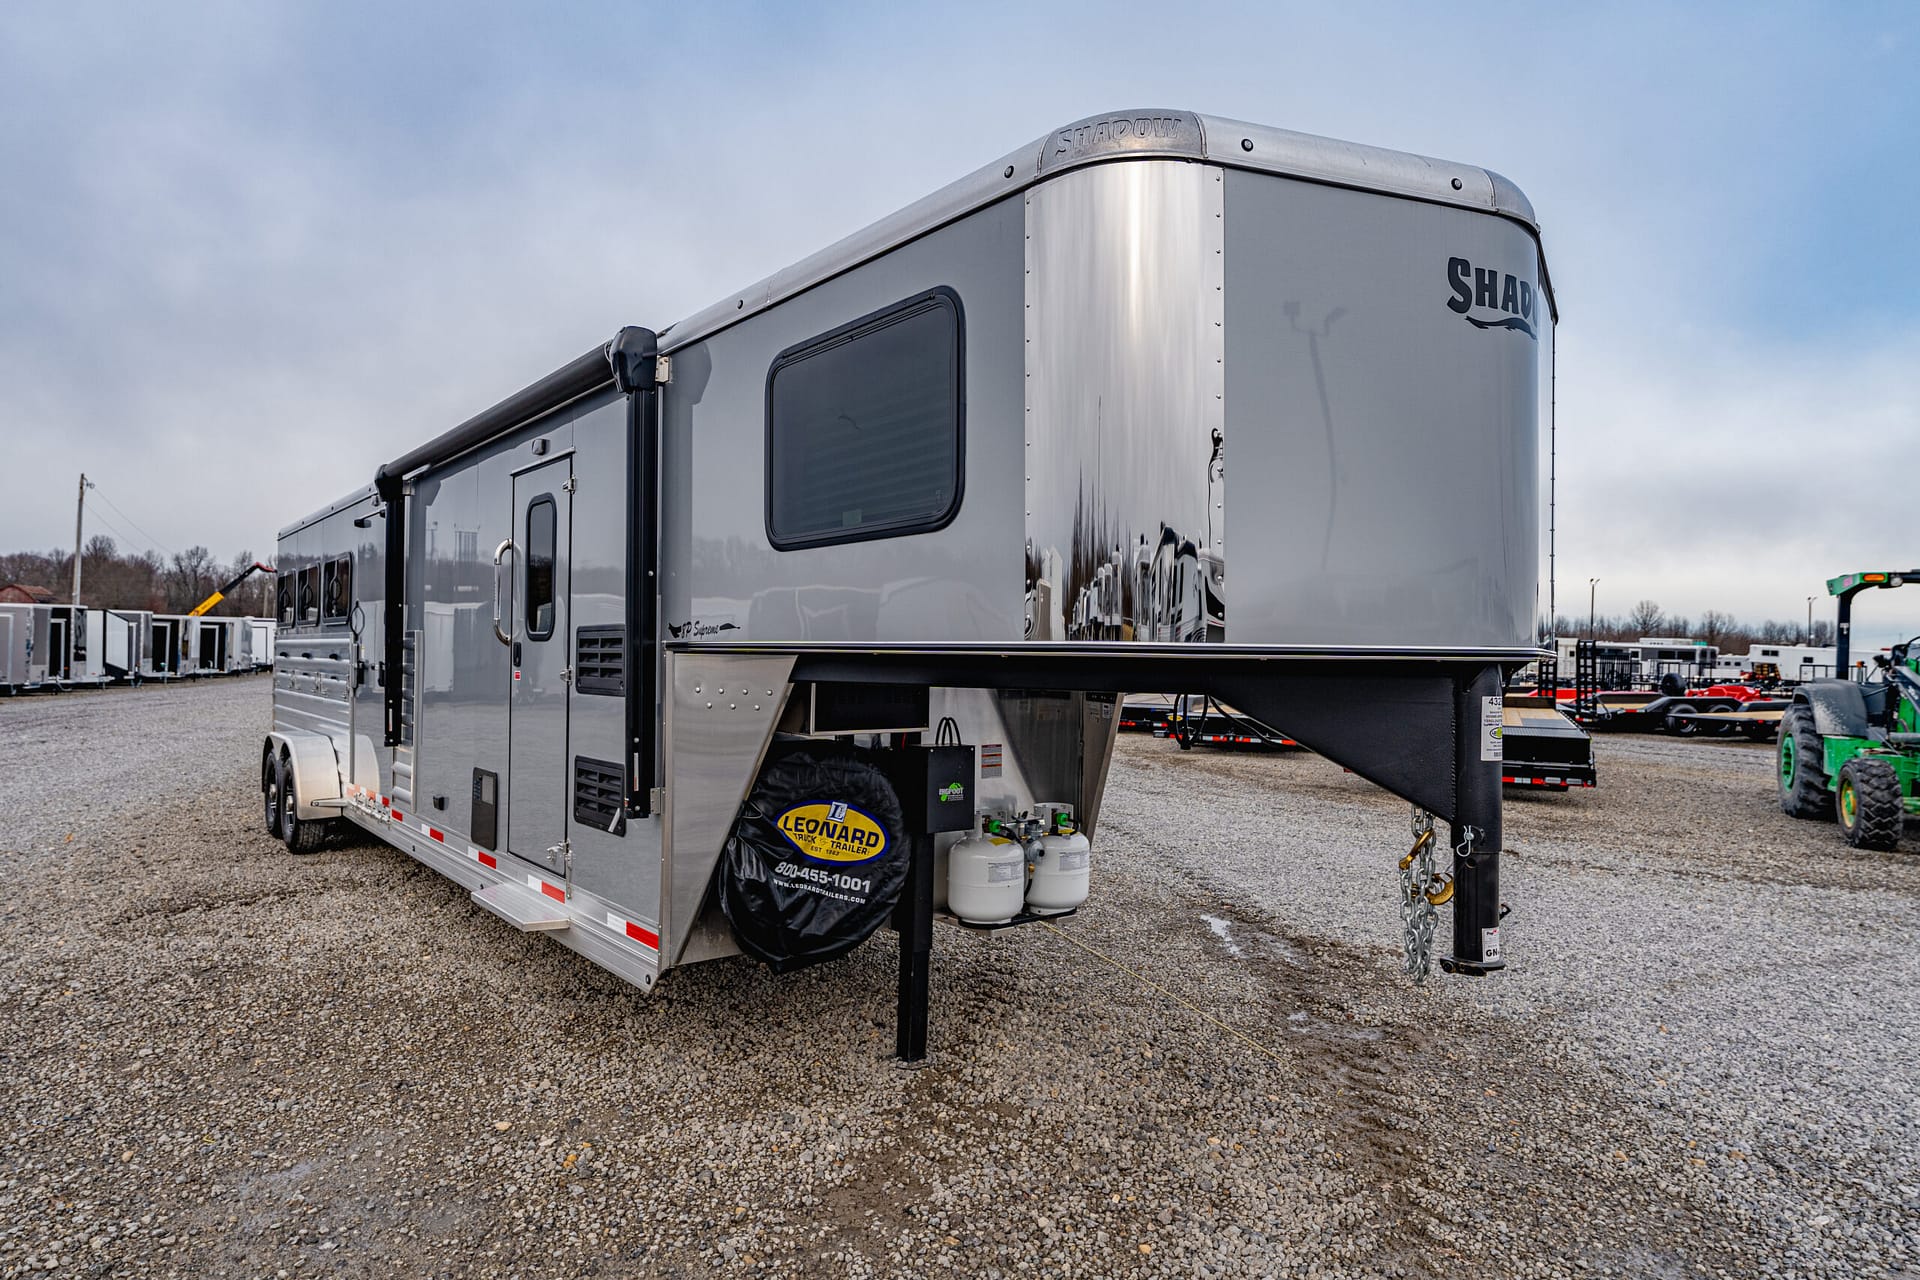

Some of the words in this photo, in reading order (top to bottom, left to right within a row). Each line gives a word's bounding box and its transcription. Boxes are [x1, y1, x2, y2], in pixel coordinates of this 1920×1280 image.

[1055, 117, 1182, 156] SHADOW
[783, 815, 880, 848] LEONARD
[793, 832, 817, 844] TRUCK
[830, 840, 868, 855] TRAILER
[775, 861, 871, 893] 800-455-1001
